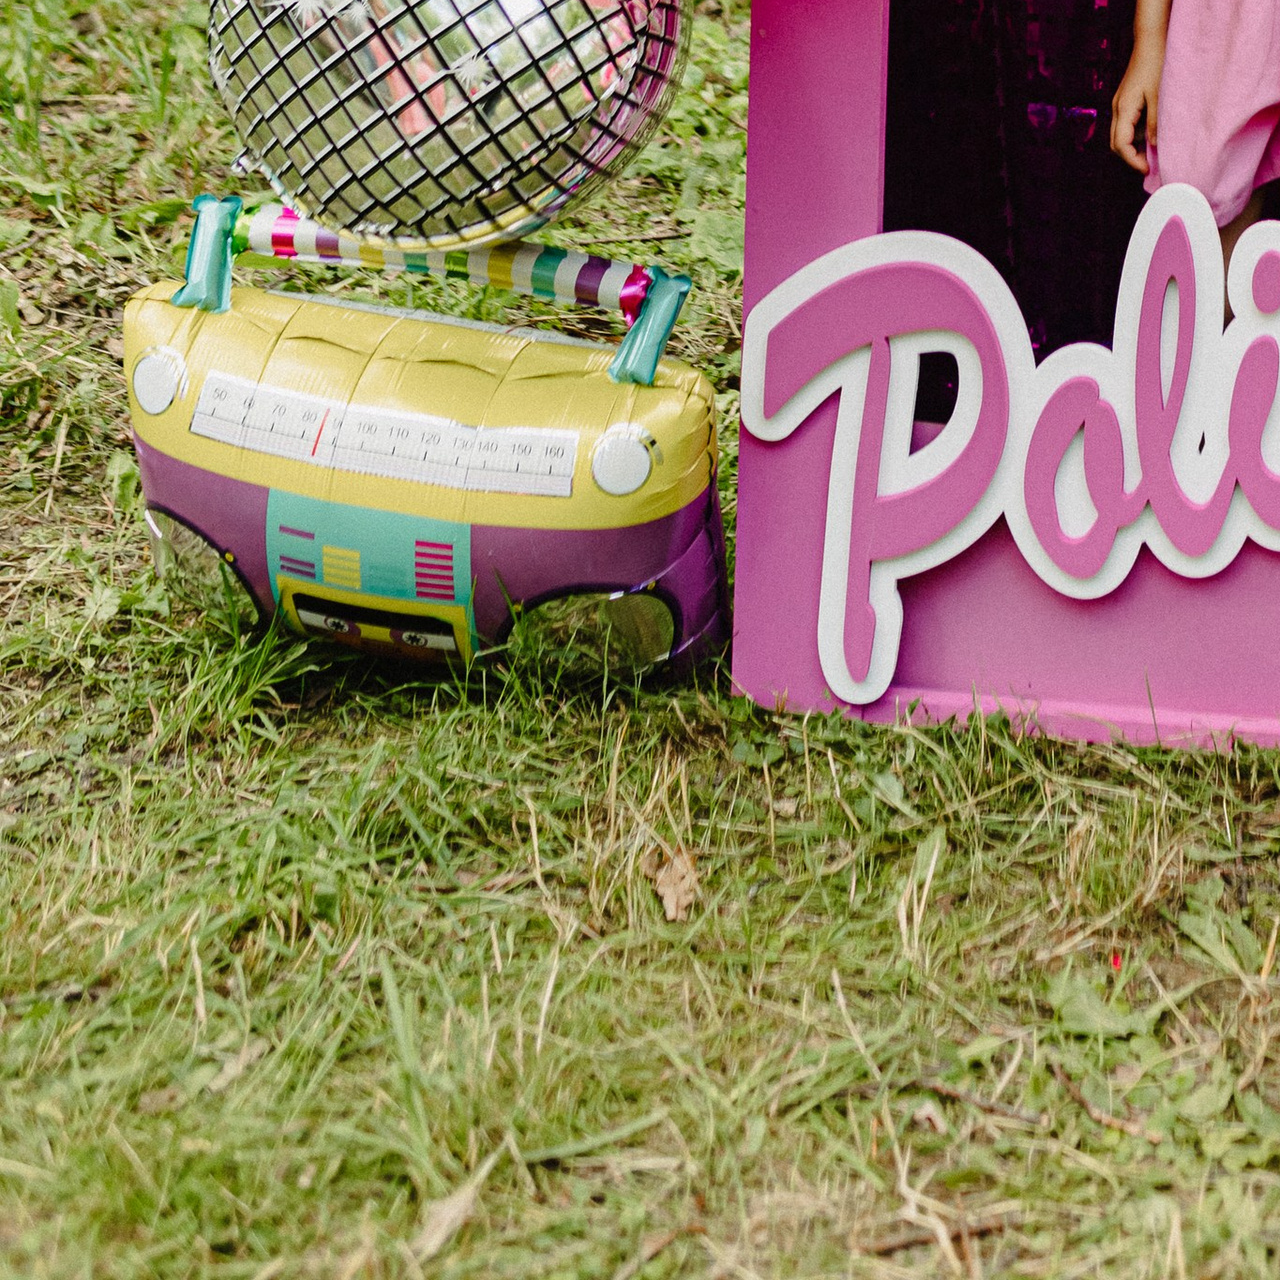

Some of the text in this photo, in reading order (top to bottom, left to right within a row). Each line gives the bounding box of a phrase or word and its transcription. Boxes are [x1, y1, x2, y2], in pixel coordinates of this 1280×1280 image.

[272, 403, 287, 418] 70
[301, 411, 317, 423] 80
[357, 422, 377, 435] 100
[389, 425, 410, 439] 110
[421, 431, 441, 446] 120
[478, 441, 499, 454] 140
[511, 443, 532, 456] 150
[544, 446, 565, 459] 160
